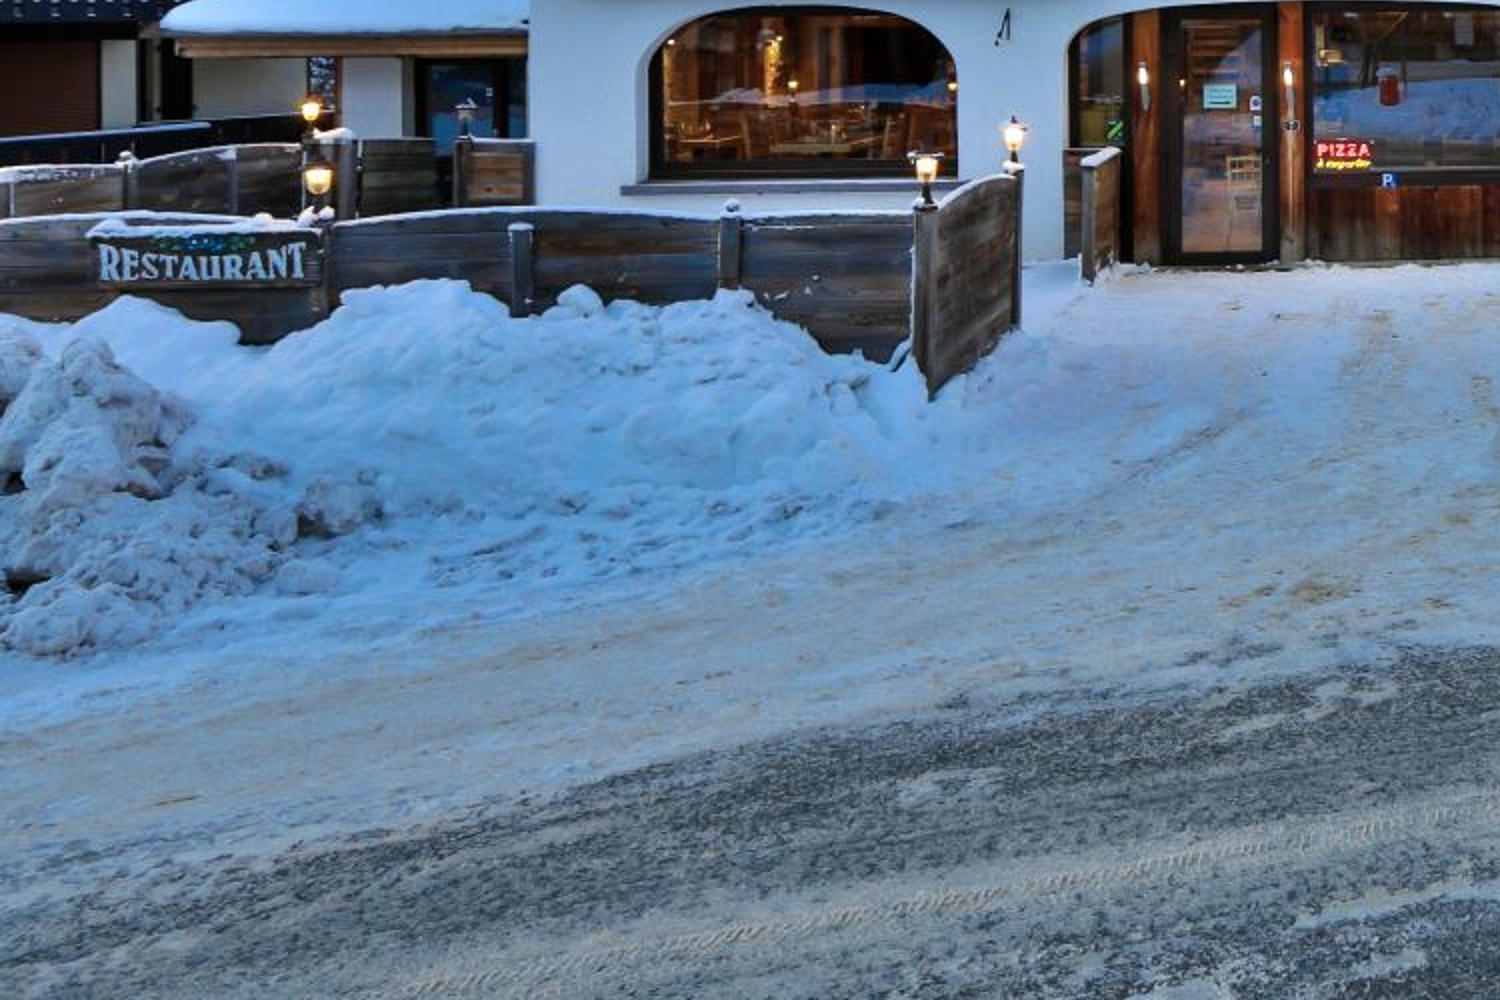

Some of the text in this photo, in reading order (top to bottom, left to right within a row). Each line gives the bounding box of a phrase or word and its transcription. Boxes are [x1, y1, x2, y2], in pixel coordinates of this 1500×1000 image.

[1317, 143, 1371, 157] PIZZA
[1382, 173, 1393, 187] P
[98, 242, 306, 281] RESTAURANT
